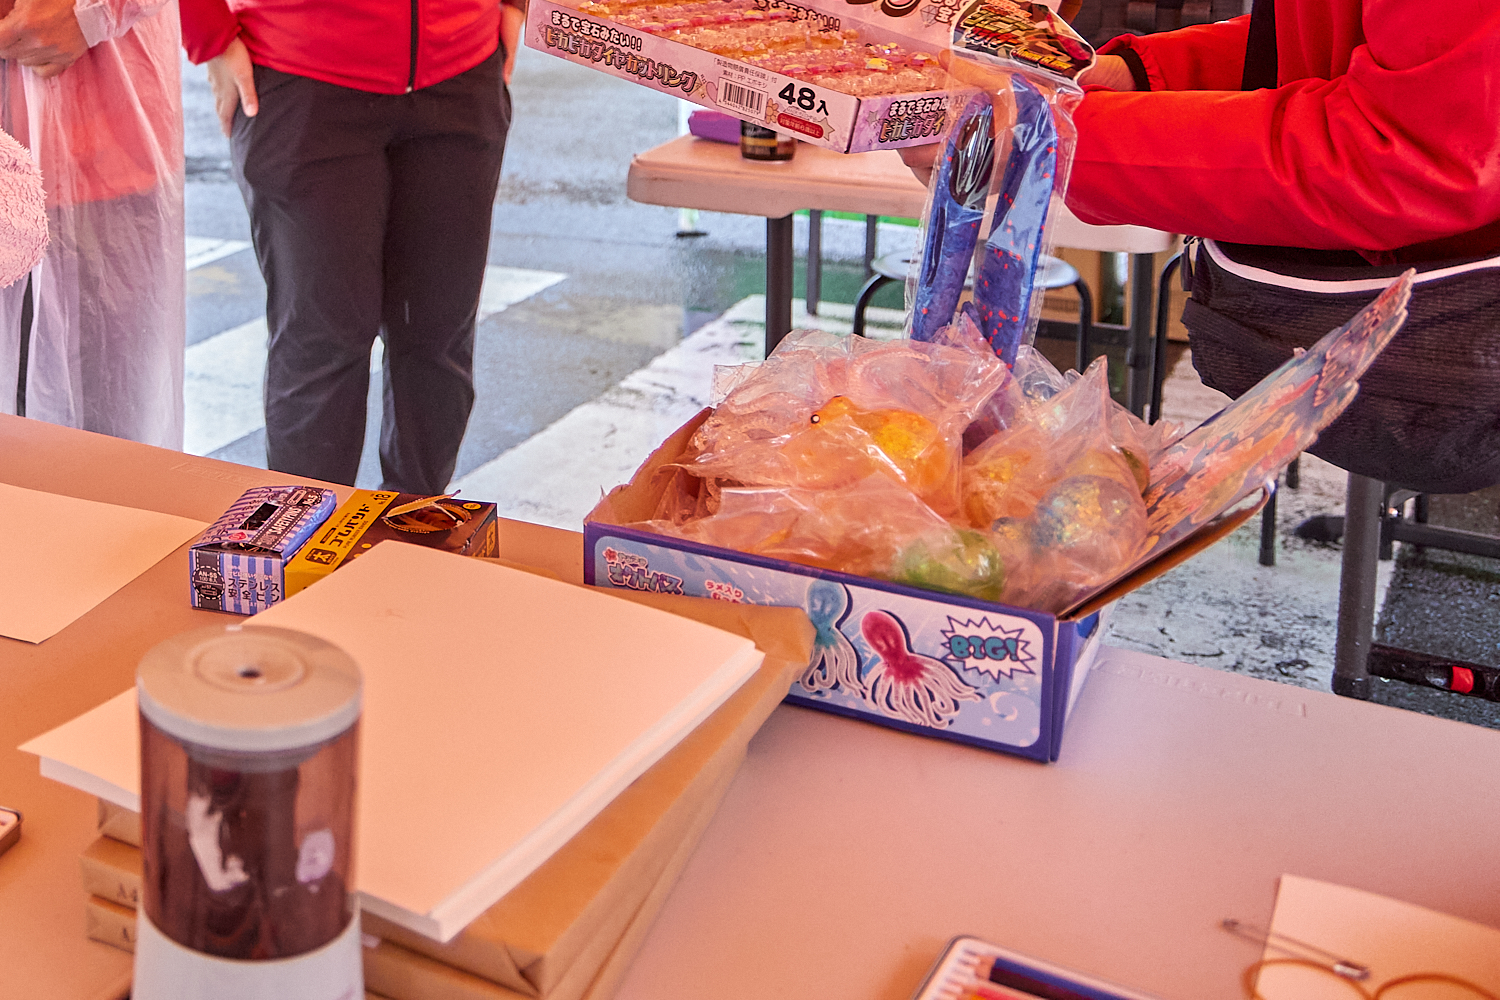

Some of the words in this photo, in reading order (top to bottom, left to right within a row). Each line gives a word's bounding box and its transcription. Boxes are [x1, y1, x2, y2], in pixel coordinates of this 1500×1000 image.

[551, 10, 642, 51] まるで宝石みたい!!
[228, 578, 280, 592] ステンレス
[228, 588, 280, 603] 安全ピン
[949, 634, 1020, 662] BIG!
